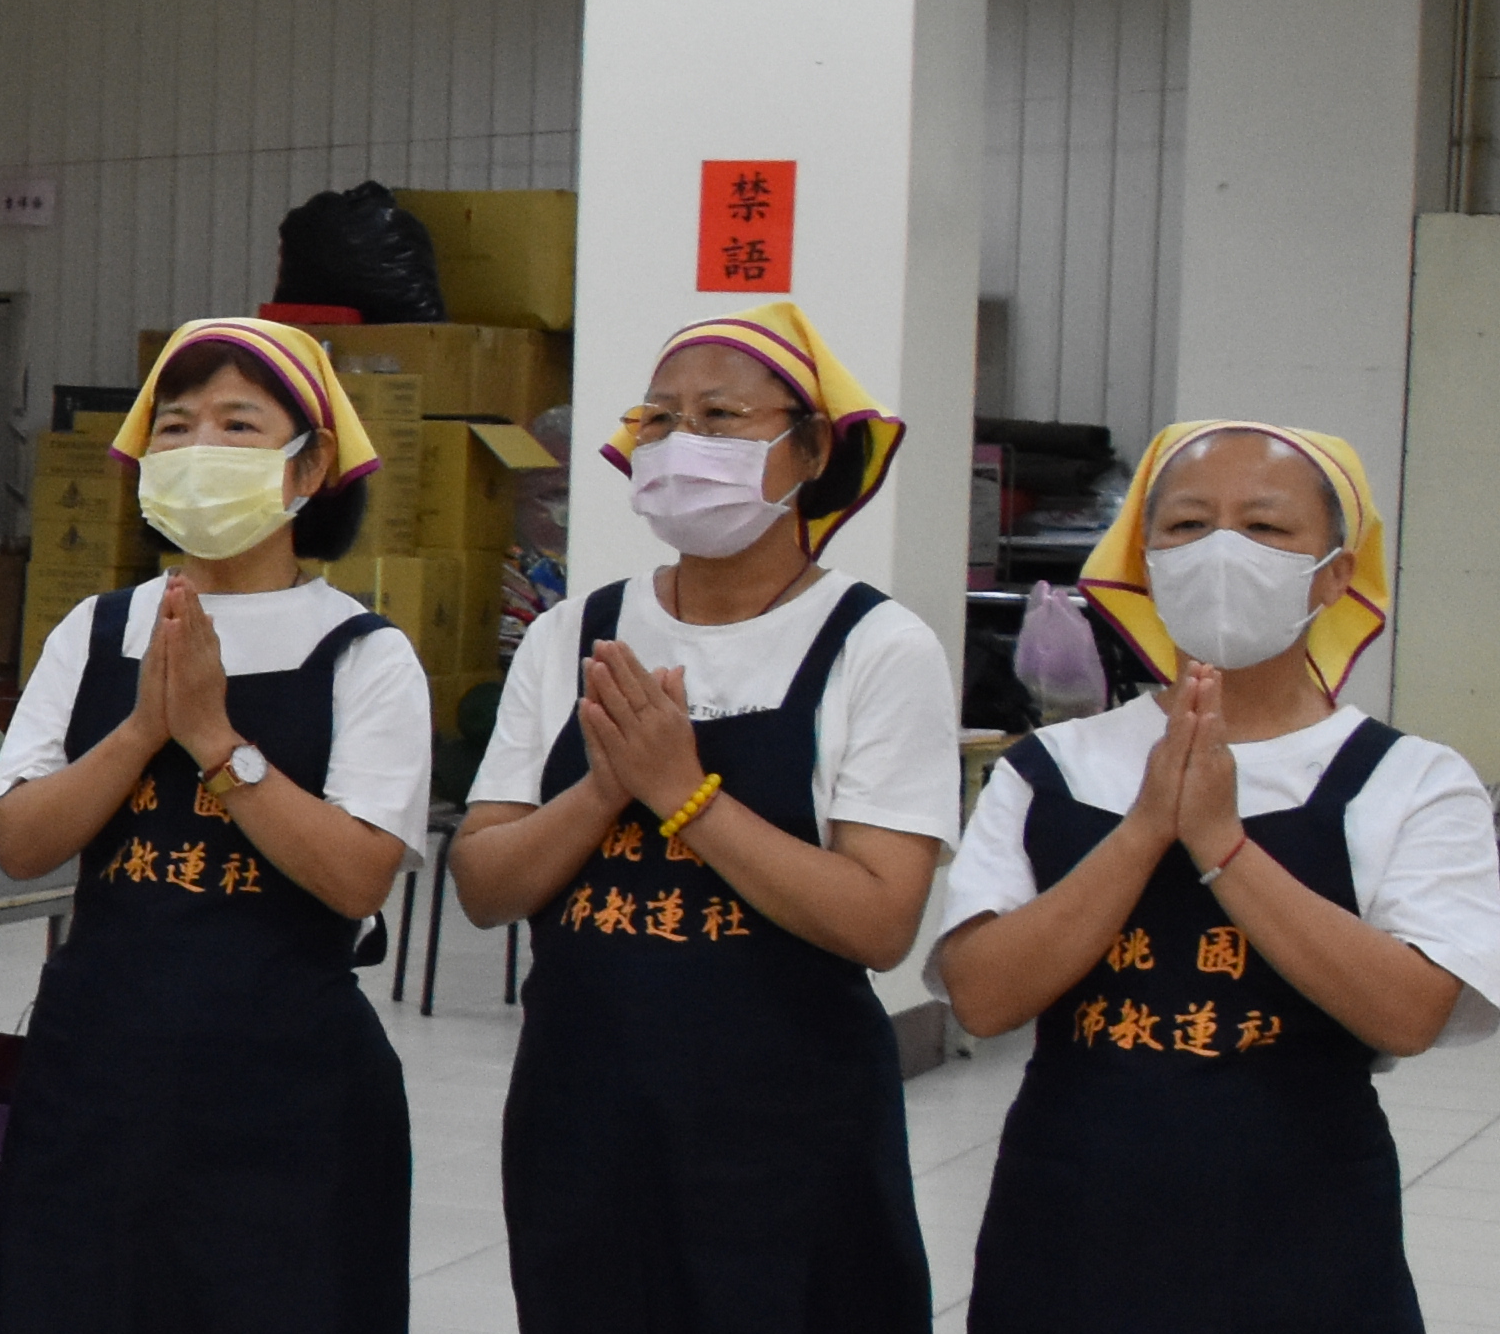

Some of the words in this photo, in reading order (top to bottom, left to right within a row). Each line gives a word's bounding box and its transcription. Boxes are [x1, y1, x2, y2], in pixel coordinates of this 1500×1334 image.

[722, 171, 771, 282] 禁語
[560, 883, 751, 942] 佛教蓮社
[1107, 926, 1249, 981] 桃園
